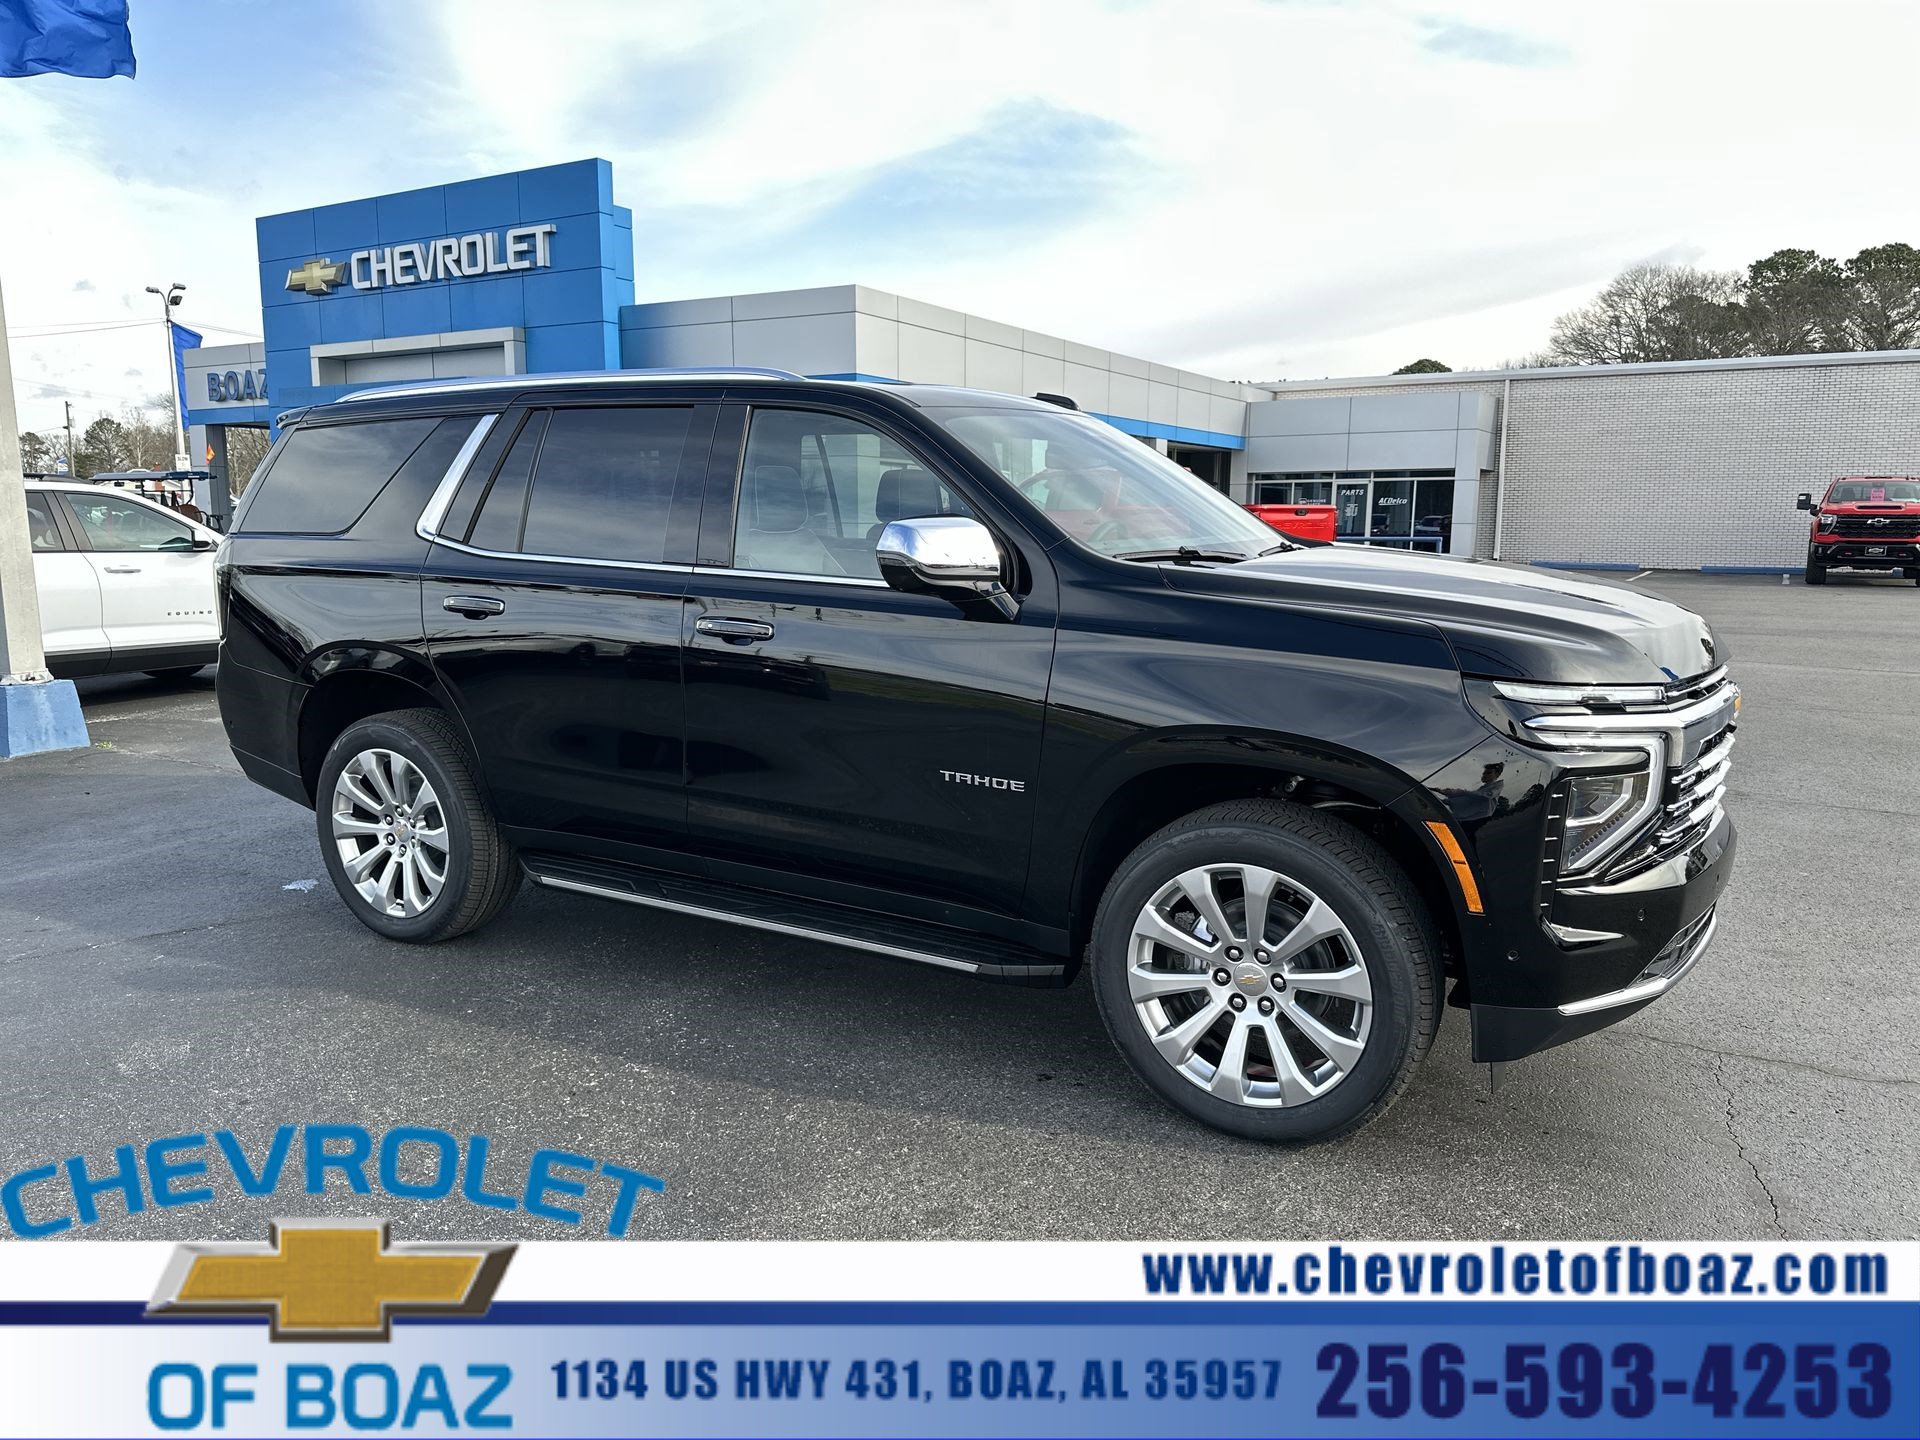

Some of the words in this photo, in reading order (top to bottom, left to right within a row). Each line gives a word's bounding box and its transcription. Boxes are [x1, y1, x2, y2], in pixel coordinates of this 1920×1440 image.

[351, 224, 557, 290] CHEVROLET
[207, 368, 269, 402] BOAZ
[1378, 497, 1408, 506] ACDelco
[939, 769, 1025, 792] TAHOE
